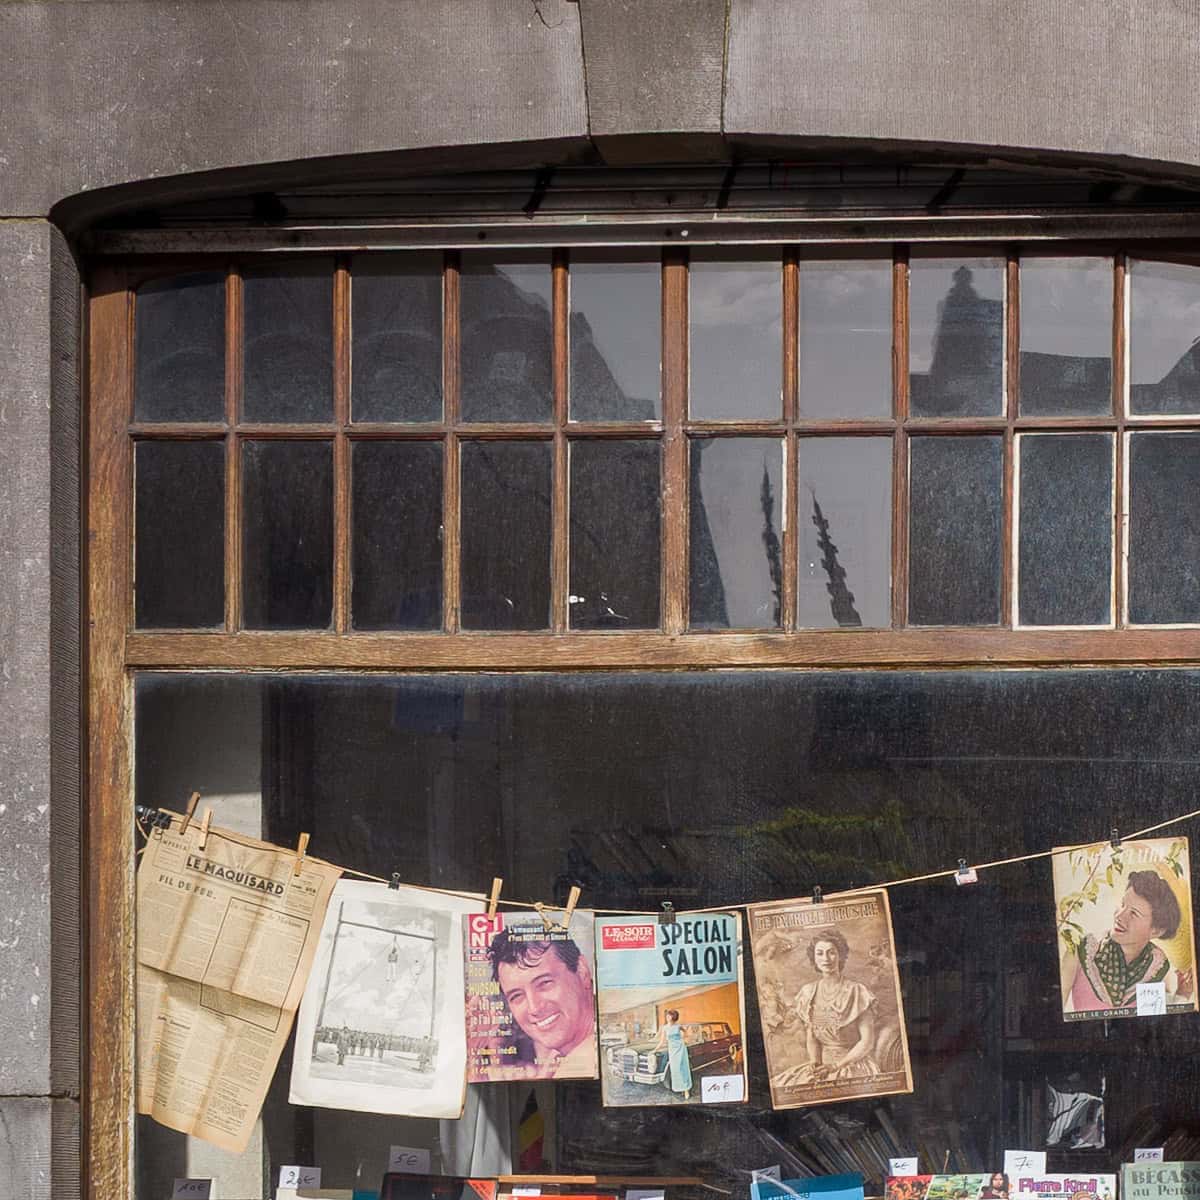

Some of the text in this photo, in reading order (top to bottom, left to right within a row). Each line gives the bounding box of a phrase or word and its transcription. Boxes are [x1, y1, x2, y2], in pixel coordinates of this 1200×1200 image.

[186, 855, 200, 869] LE
[205, 862, 285, 896] MAQUISARD
[661, 918, 731, 946] SPECIAL
[663, 945, 732, 977] SALON
